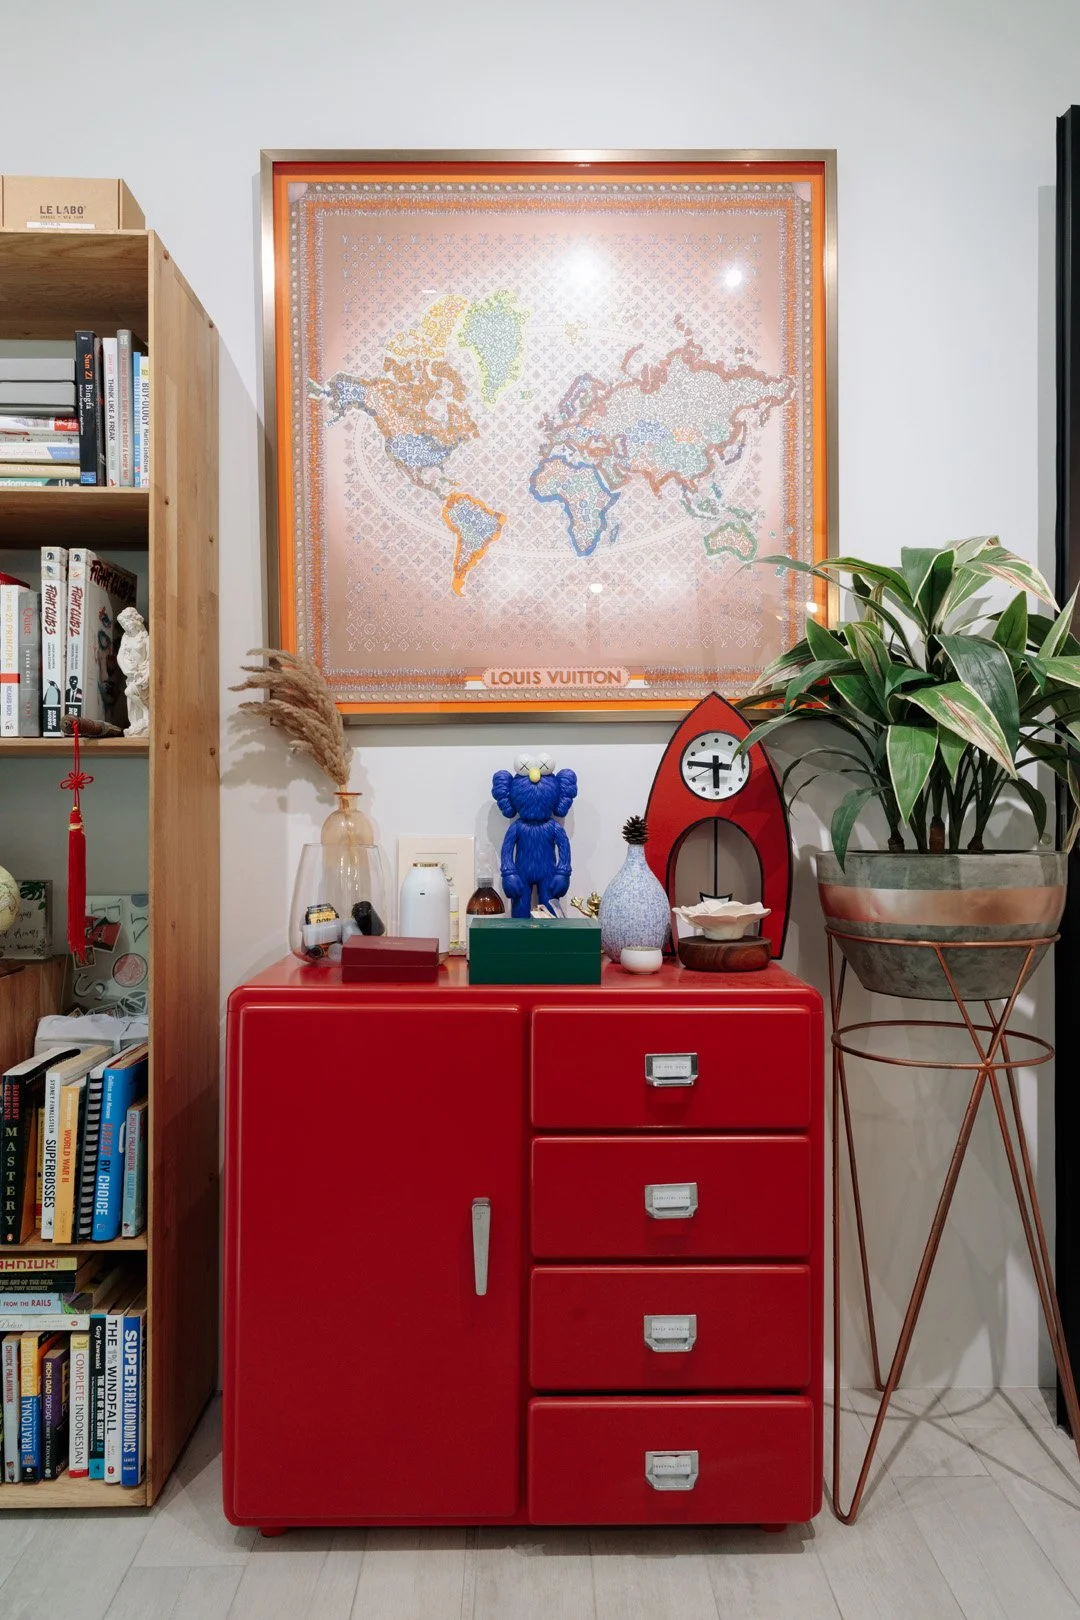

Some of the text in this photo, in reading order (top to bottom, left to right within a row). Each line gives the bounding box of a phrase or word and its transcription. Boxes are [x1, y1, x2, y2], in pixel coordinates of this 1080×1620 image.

[40, 205, 84, 215] LE LABO
[83, 353, 94, 409] Sun Zi Bingfa
[44, 584, 58, 635] FIGHT CLUB 3
[71, 585, 83, 610] FIGHT
[22, 607, 35, 638] Quiet
[69, 608, 81, 630] CLUB
[69, 626, 80, 637] 2
[490, 671, 621, 685] LOUIS VUITTON
[63, 1129, 72, 1156] WORLD
[5, 1127, 18, 1225] MASTERY
[44, 1139, 57, 1208] SUPERBOSSES
[62, 1159, 71, 1176] WAR
[96, 1123, 114, 1216] GREAT BY CHOICE
[94, 1325, 102, 1339] Guy
[75, 1353, 85, 1401] COMPLETE
[97, 1375, 105, 1386] THE
[107, 1320, 118, 1435] THE 1% WINDFALL
[123, 1329, 138, 1453] SUPERFREAKONOMICS
[97, 1401, 104, 1409] OF
[21, 1398, 33, 1453] IRRATIONAL
[75, 1404, 84, 1464] INDONESIAN
[96, 1421, 104, 1440] START
